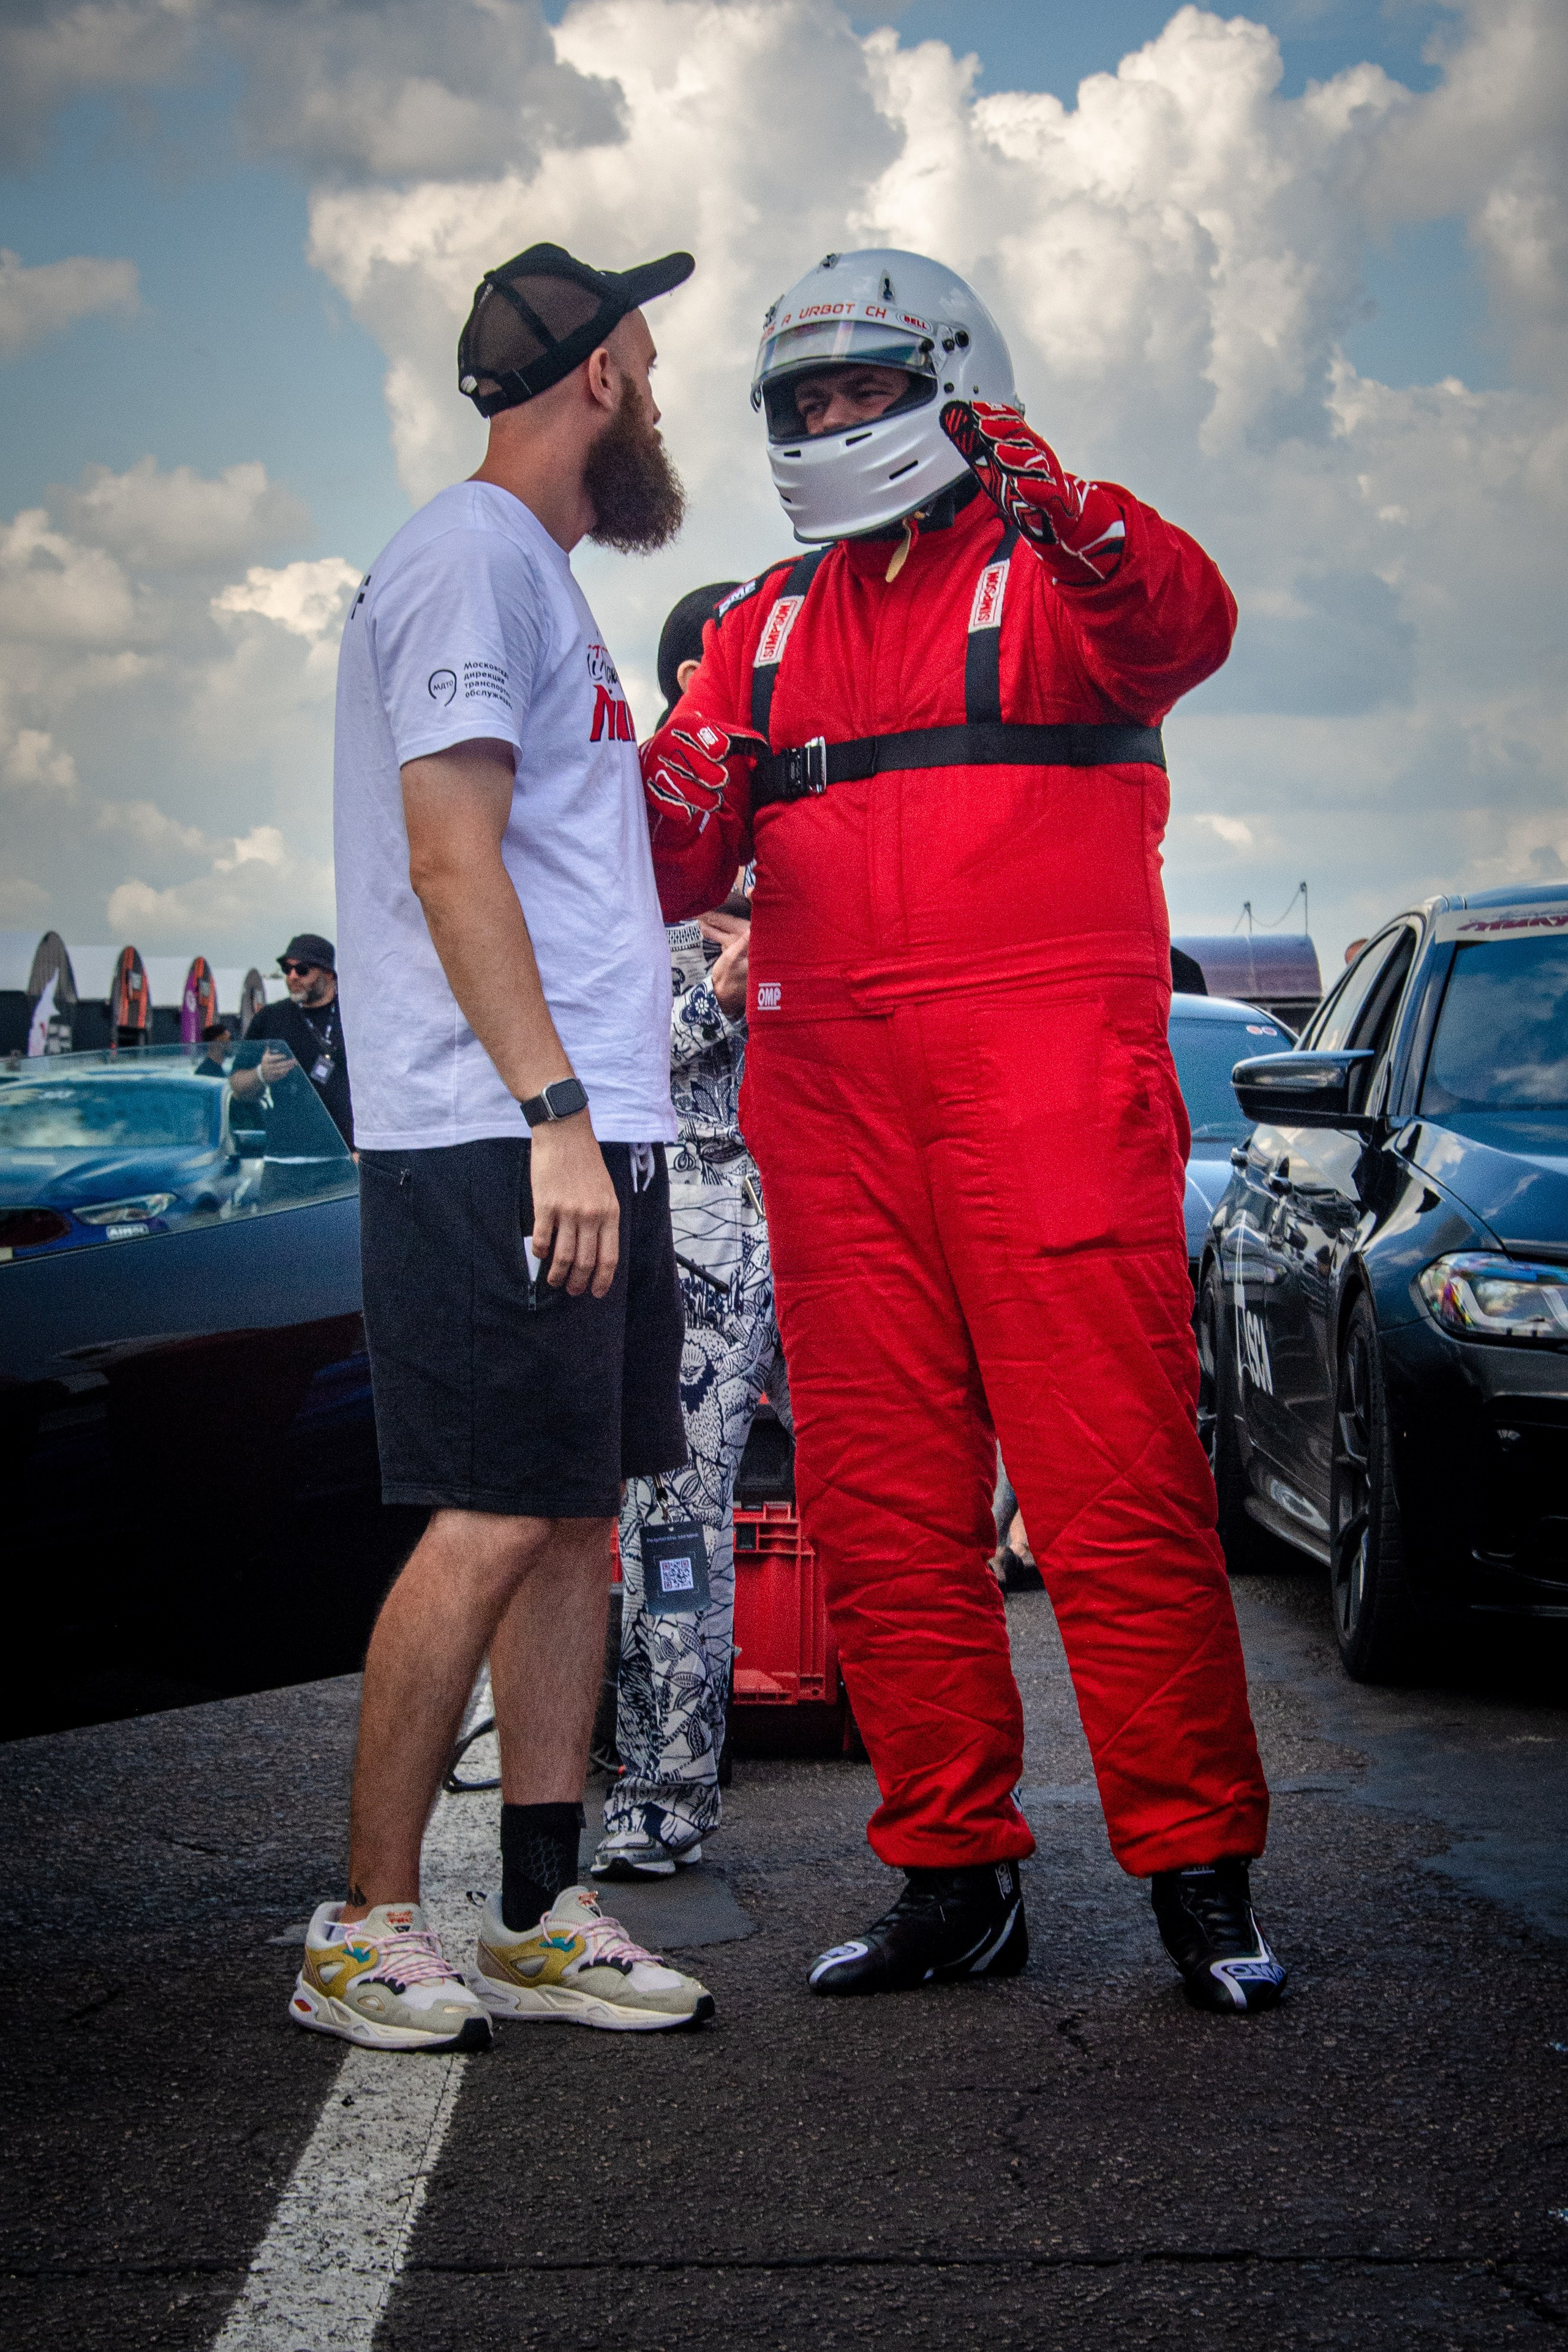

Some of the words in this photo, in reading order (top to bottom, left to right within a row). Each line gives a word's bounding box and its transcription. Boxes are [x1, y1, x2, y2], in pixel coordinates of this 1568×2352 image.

[865, 306, 887, 318] CH
[903, 315, 927, 330] BELL
[464, 671, 505, 685] дирекция
[757, 987, 782, 1007] OMP
